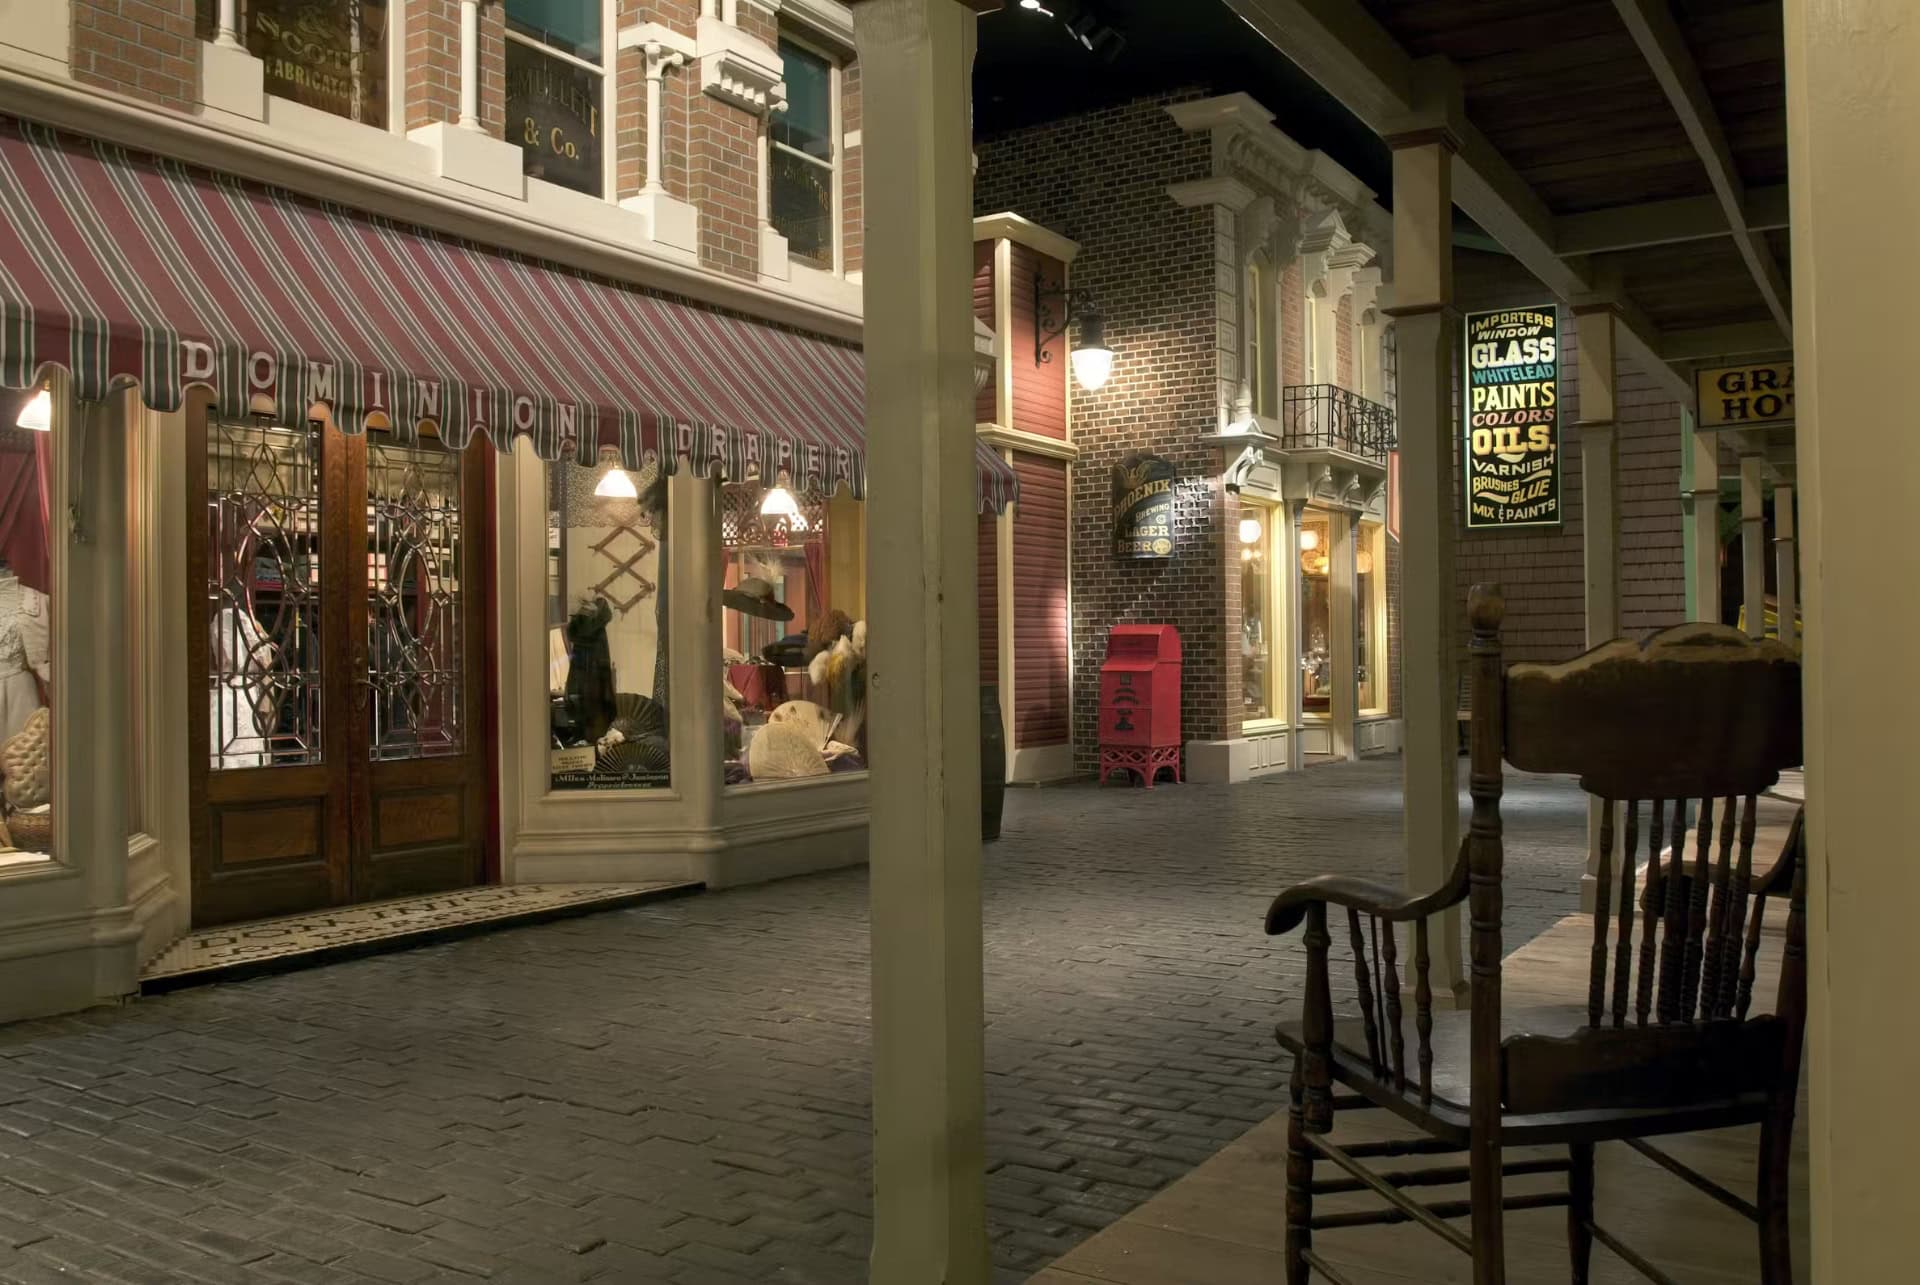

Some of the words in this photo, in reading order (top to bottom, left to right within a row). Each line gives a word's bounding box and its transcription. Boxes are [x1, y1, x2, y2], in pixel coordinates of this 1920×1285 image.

[524, 117, 540, 147] &
[550, 127, 580, 159] Co.
[1471, 312, 1554, 335] IMPORTERS
[1477, 325, 1541, 341] WINDOW
[1471, 336, 1556, 369] GLASS
[1472, 364, 1555, 385] WHITELEAD
[180, 340, 577, 437] DOMINION
[1472, 381, 1555, 412] PAINTS
[1472, 408, 1555, 427] COLORS
[1472, 450, 1554, 476] VARNISH
[1473, 476, 1519, 494] BRUSHES
[1511, 479, 1551, 504] GLUE
[1113, 479, 1171, 530] PHOENIX
[1135, 503, 1170, 523] BREWING
[1473, 502, 1495, 519] MIX
[1506, 498, 1556, 520] PAINTS
[1125, 525, 1170, 537] LAGER
[1118, 540, 1152, 553] BEER
[191, 885, 551, 951] DOMINION
